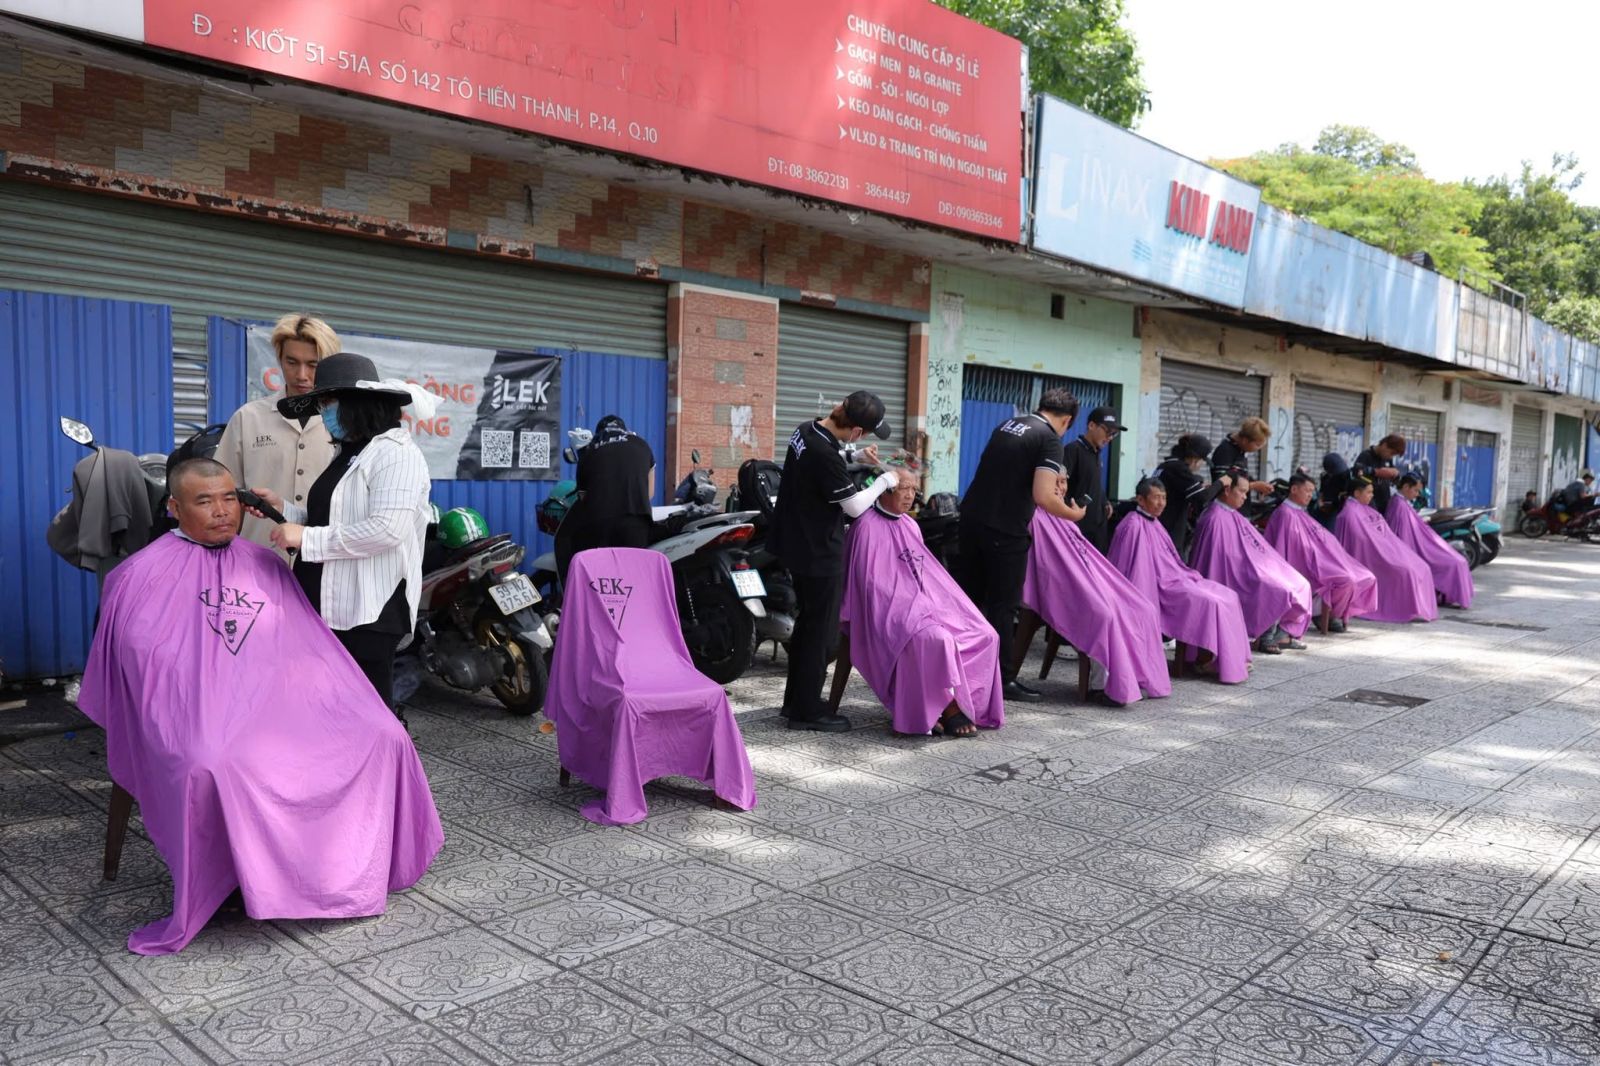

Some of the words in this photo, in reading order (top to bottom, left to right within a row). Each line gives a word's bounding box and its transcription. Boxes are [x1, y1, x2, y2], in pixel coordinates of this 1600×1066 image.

[847, 14, 895, 46] CHUYÊN
[898, 34, 929, 60] CUNG
[246, 26, 298, 57] KIỐT
[411, 68, 441, 92] 142
[446, 77, 473, 99] TÔ
[628, 122, 658, 144] Q.10
[847, 43, 877, 65] GẠCH
[880, 55, 902, 74] MEN
[923, 71, 962, 97] GRANITE
[848, 96, 870, 115] KEO
[896, 113, 922, 132] GẠCH
[850, 127, 877, 146] VLXD
[889, 138, 921, 159] TRANG
[958, 160, 985, 180] NGOẠI
[805, 167, 849, 190] 38622131
[503, 379, 551, 404] LEK
